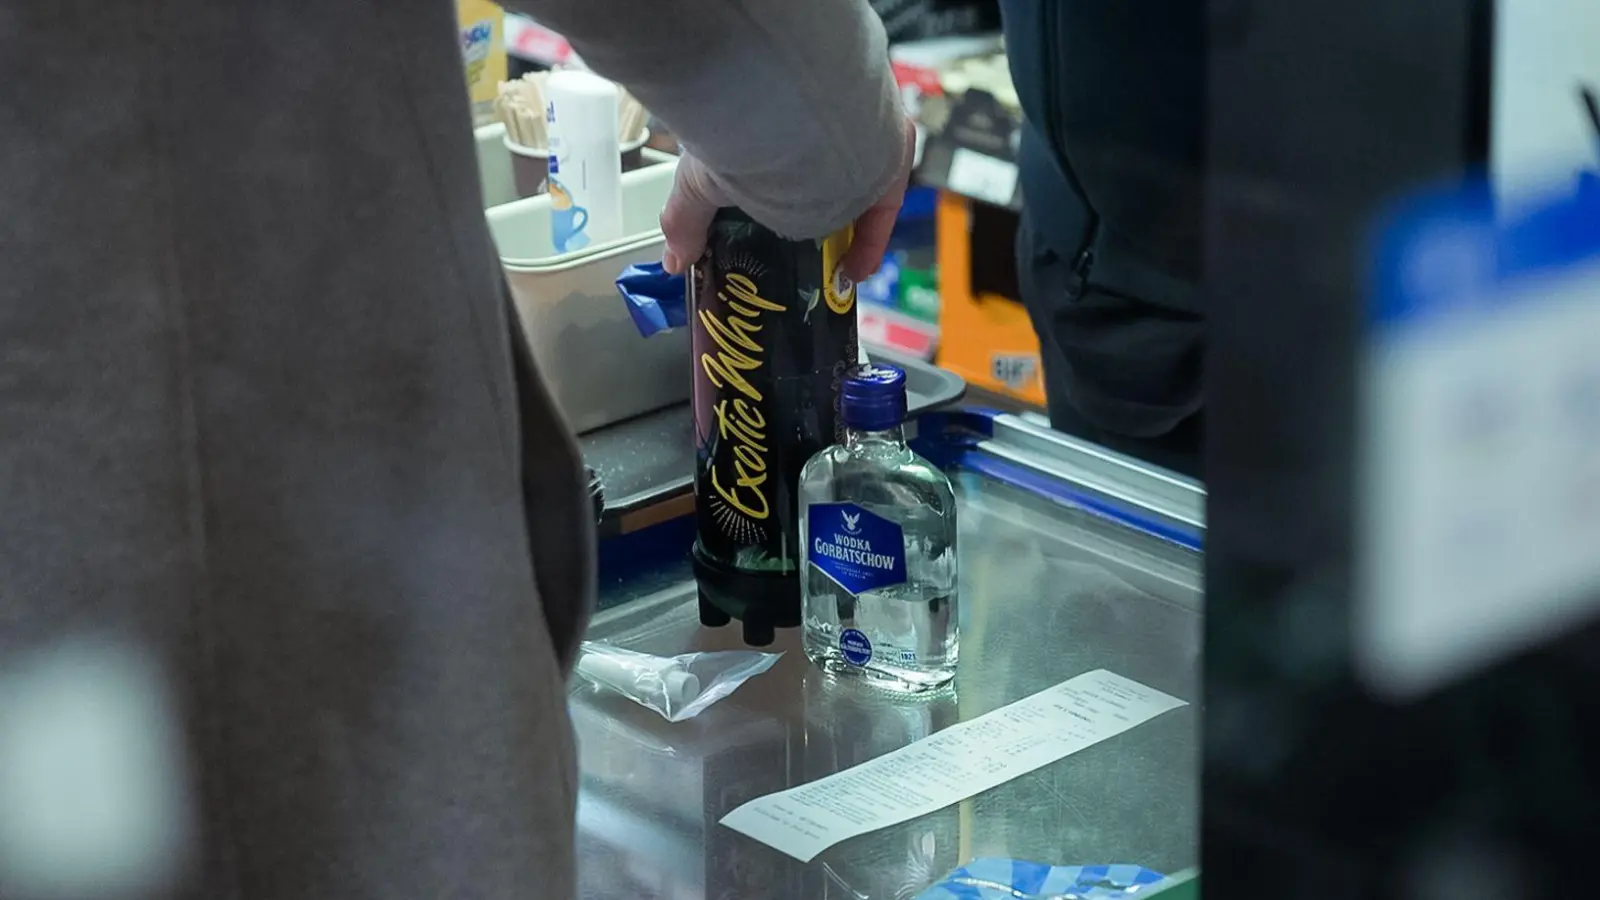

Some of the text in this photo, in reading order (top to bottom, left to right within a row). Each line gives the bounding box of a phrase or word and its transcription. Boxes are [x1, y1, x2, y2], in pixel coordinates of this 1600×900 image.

[699, 272, 787, 520] Exotic Whip
[814, 537, 895, 571] GORBATSCHOW
[834, 533, 872, 552] WODKA
